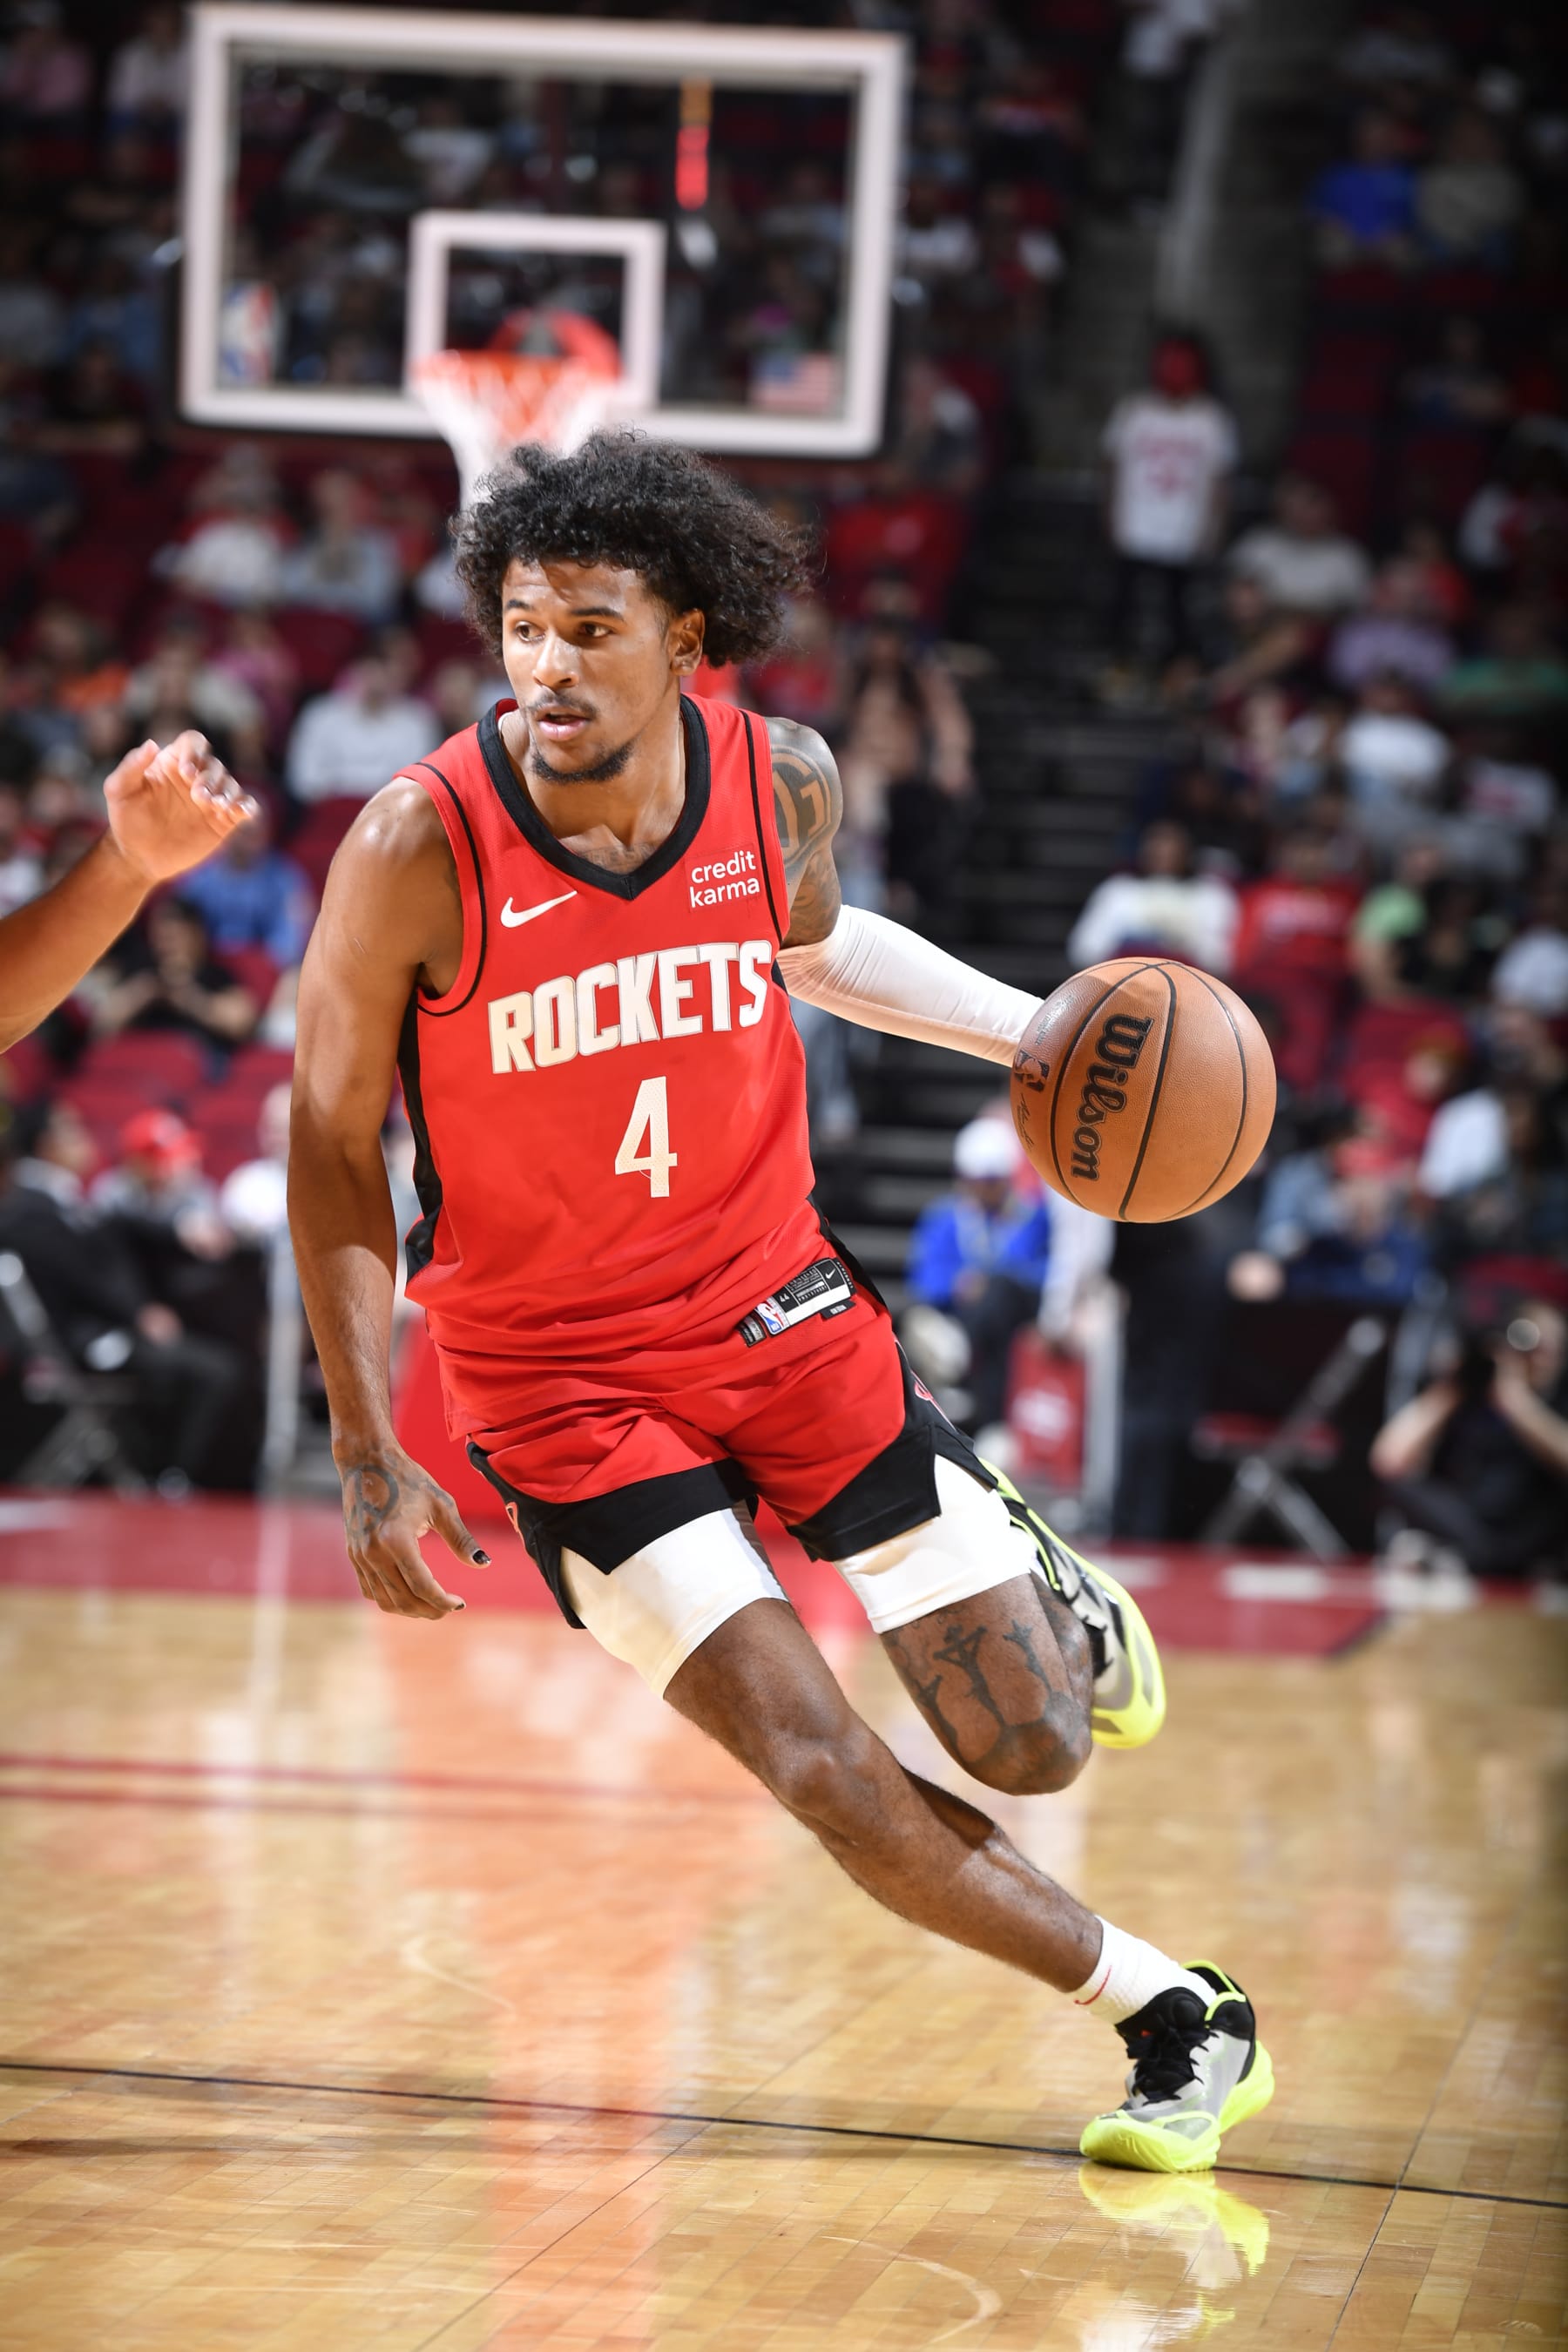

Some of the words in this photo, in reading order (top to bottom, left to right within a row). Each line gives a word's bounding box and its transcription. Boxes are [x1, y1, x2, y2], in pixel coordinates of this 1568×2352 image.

[690, 877, 760, 908] karma
[691, 850, 756, 883] credit
[488, 940, 772, 1074] ROCKETS
[615, 1076, 678, 1198] 4
[1071, 1013, 1154, 1181] Wilson
